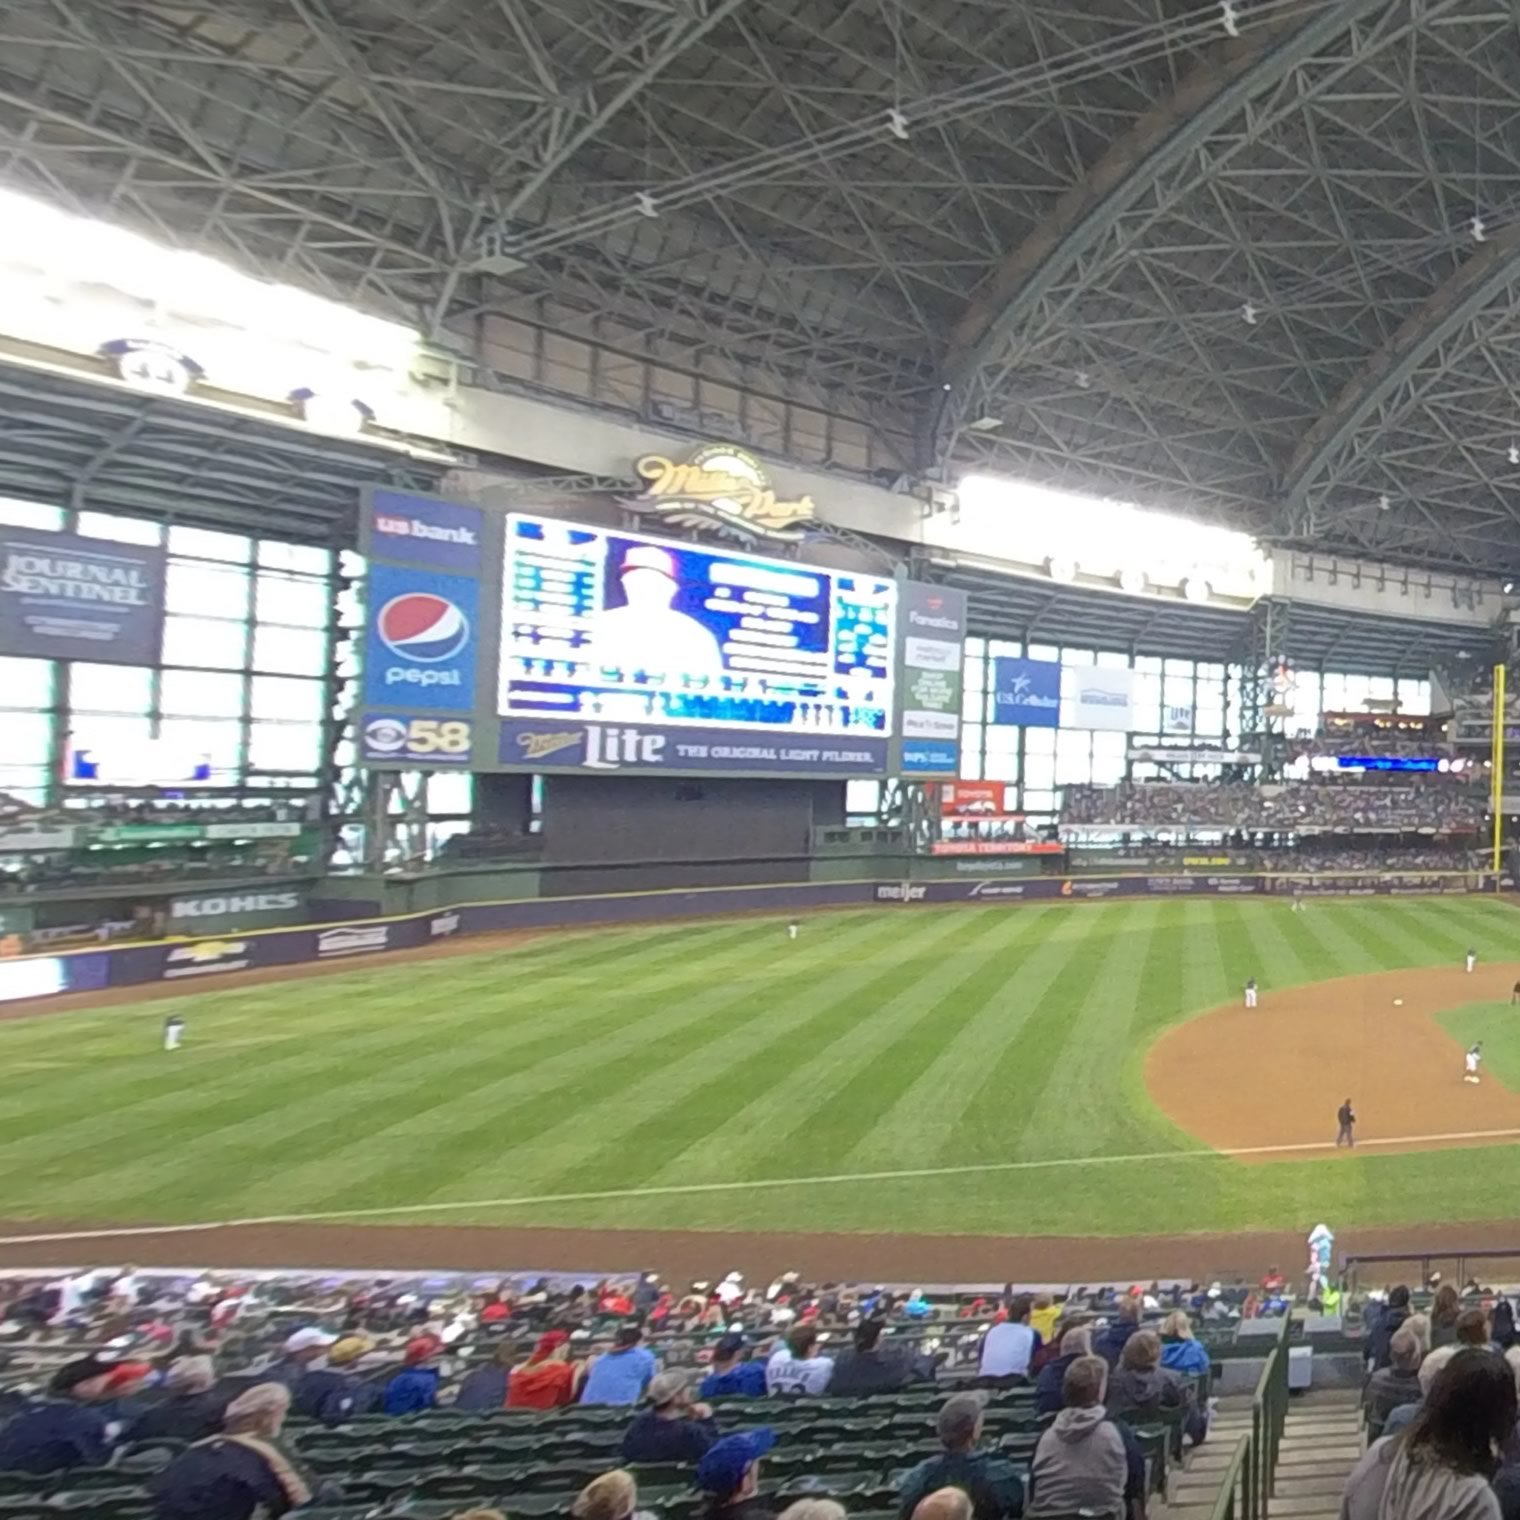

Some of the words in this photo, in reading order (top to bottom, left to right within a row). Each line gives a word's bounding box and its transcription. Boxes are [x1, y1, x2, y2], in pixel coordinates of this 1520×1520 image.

[637, 456, 752, 500] Miller
[376, 516, 410, 536] us
[411, 519, 477, 545] bank
[4, 554, 147, 588] JOURNAL
[0, 575, 148, 606] SENTINEL
[909, 611, 959, 631] Fanatics
[384, 666, 462, 687] pepsi
[406, 720, 472, 753] 58
[582, 725, 666, 769] Lite
[676, 744, 709, 757] THE
[710, 745, 778, 761] ORIGINAL
[877, 884, 928, 903] meijer
